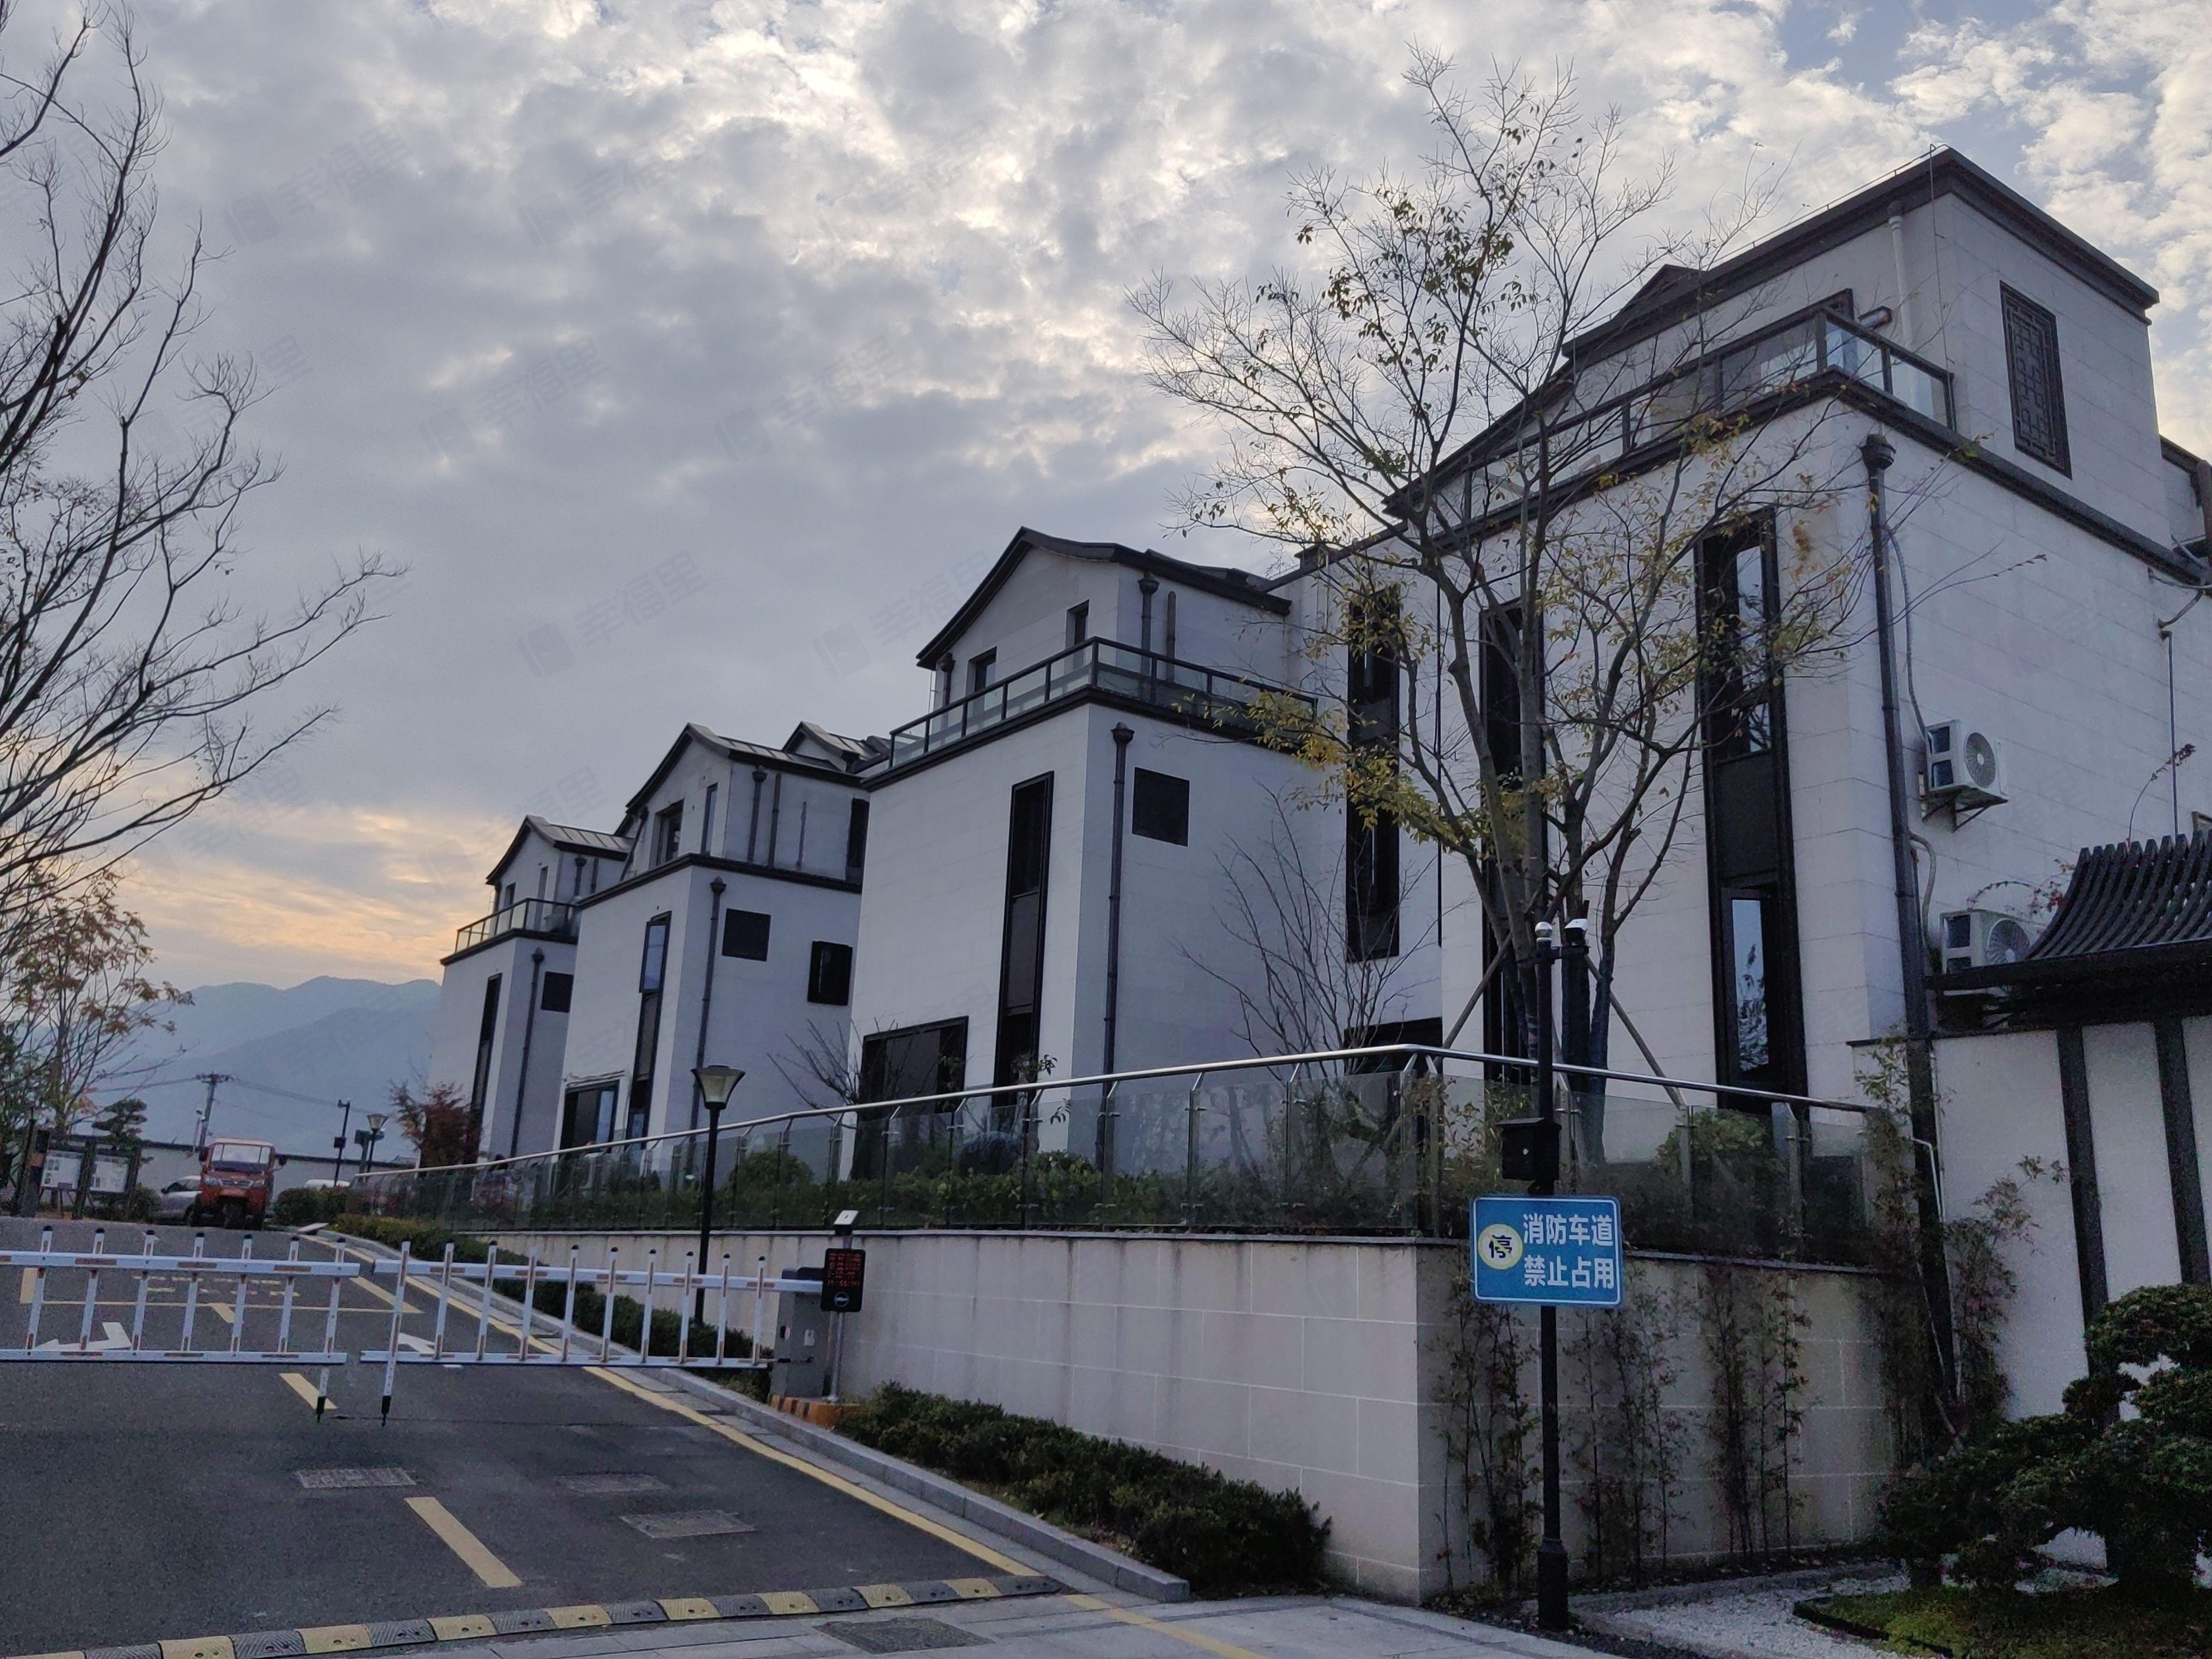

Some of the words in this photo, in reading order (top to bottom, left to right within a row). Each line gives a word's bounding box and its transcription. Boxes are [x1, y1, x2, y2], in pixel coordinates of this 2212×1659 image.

[1523, 1213, 1613, 1246] 消防车道
[1524, 1255, 1614, 1289] 禁止占用
